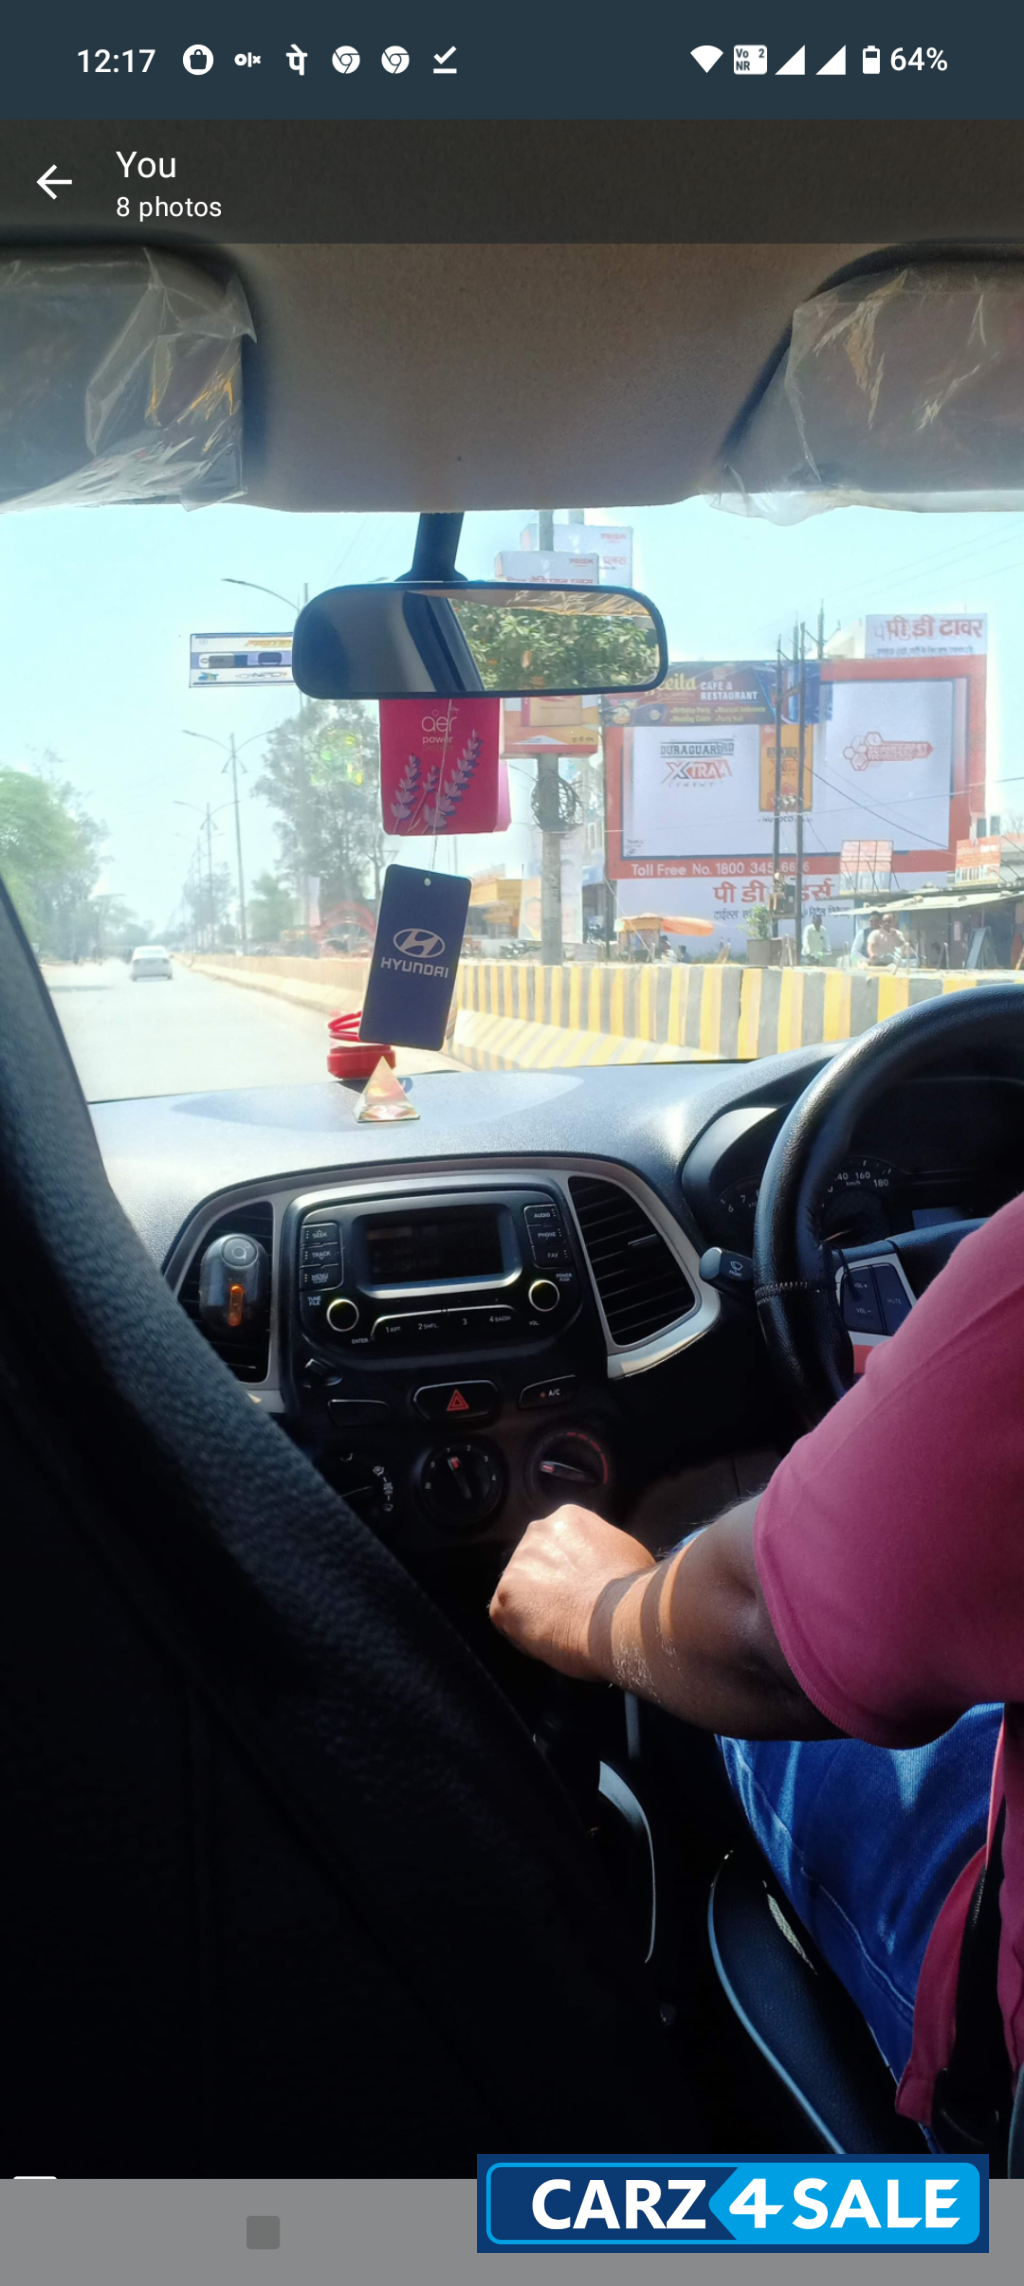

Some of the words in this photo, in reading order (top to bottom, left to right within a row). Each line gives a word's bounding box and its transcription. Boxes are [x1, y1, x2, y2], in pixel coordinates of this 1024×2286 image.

[700, 681, 723, 691] CAFE
[726, 681, 733, 690] &
[700, 691, 758, 700] RESTAURANT
[421, 715, 458, 732] aer
[660, 742, 734, 755] DURAGUARD
[763, 815, 794, 823] NUOCO
[631, 864, 654, 877] Toll
[657, 864, 687, 876] Free
[692, 863, 712, 876] No.
[716, 862, 745, 875] 1800
[750, 861, 774, 874] 345
[781, 861, 810, 873] 666
[713, 880, 736, 904] पी
[740, 879, 767, 904] डी
[381, 956, 449, 979] HYUNDAI
[855, 1171, 871, 1180] 160
[873, 1178, 889, 1188] 180
[740, 1194, 746, 1203] 7
[728, 1204, 734, 1213] 6
